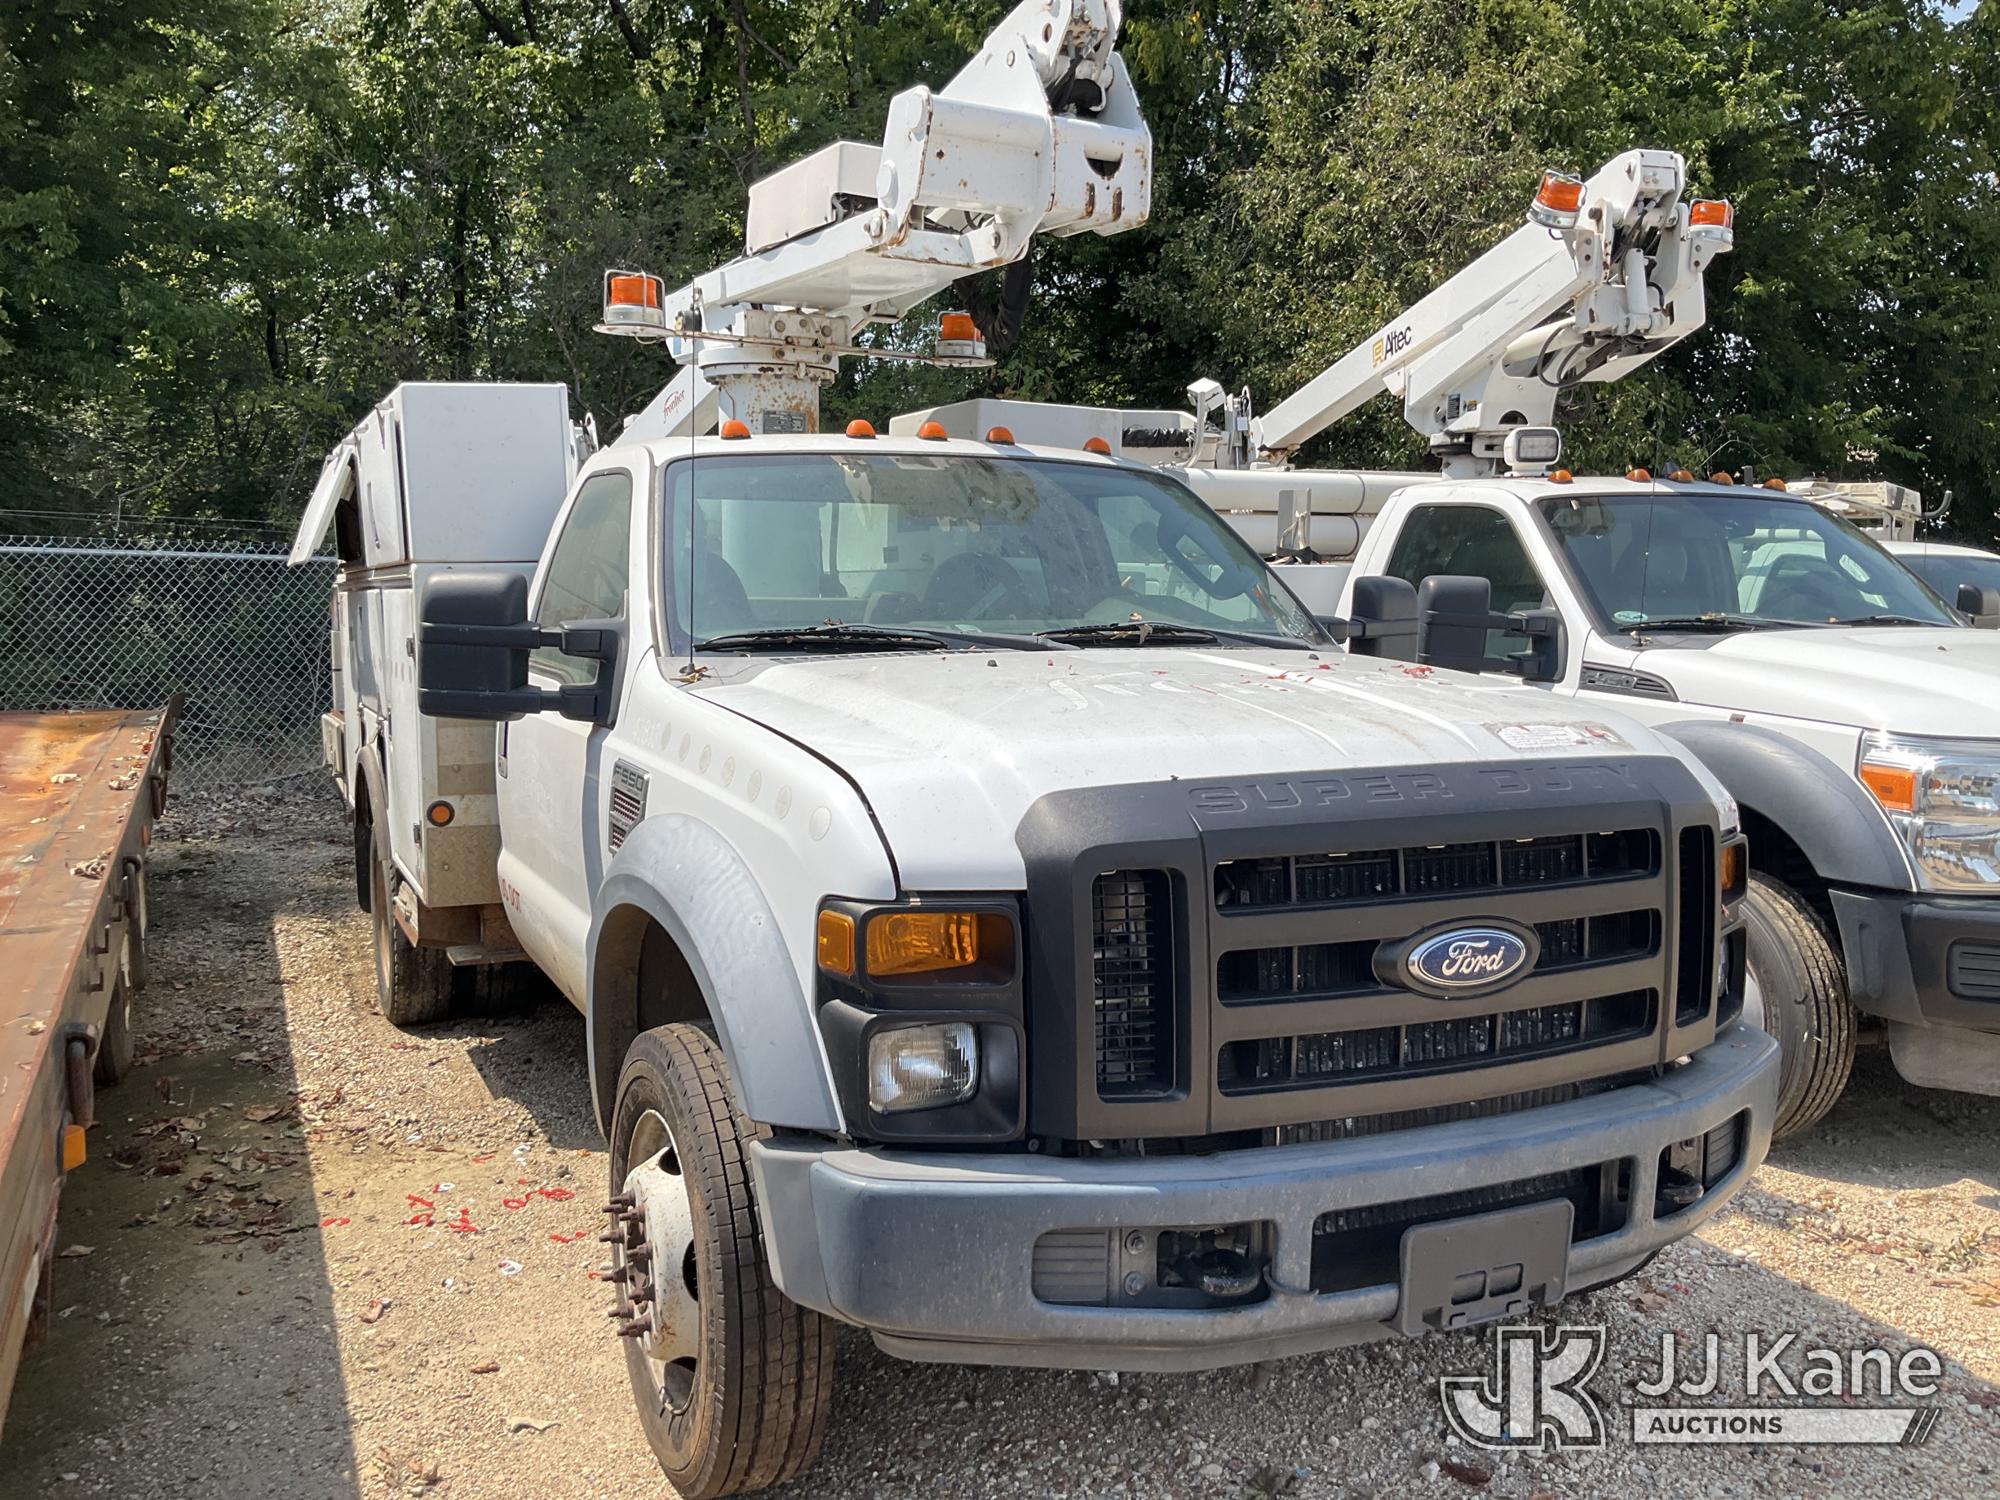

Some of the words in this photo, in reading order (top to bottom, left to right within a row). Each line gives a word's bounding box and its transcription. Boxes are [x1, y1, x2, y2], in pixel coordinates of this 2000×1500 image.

[1383, 326, 1412, 360] Altec
[1187, 773, 1455, 814] SUPER
[1477, 763, 1640, 794] DUTY
[1441, 940, 1506, 977] Ford
